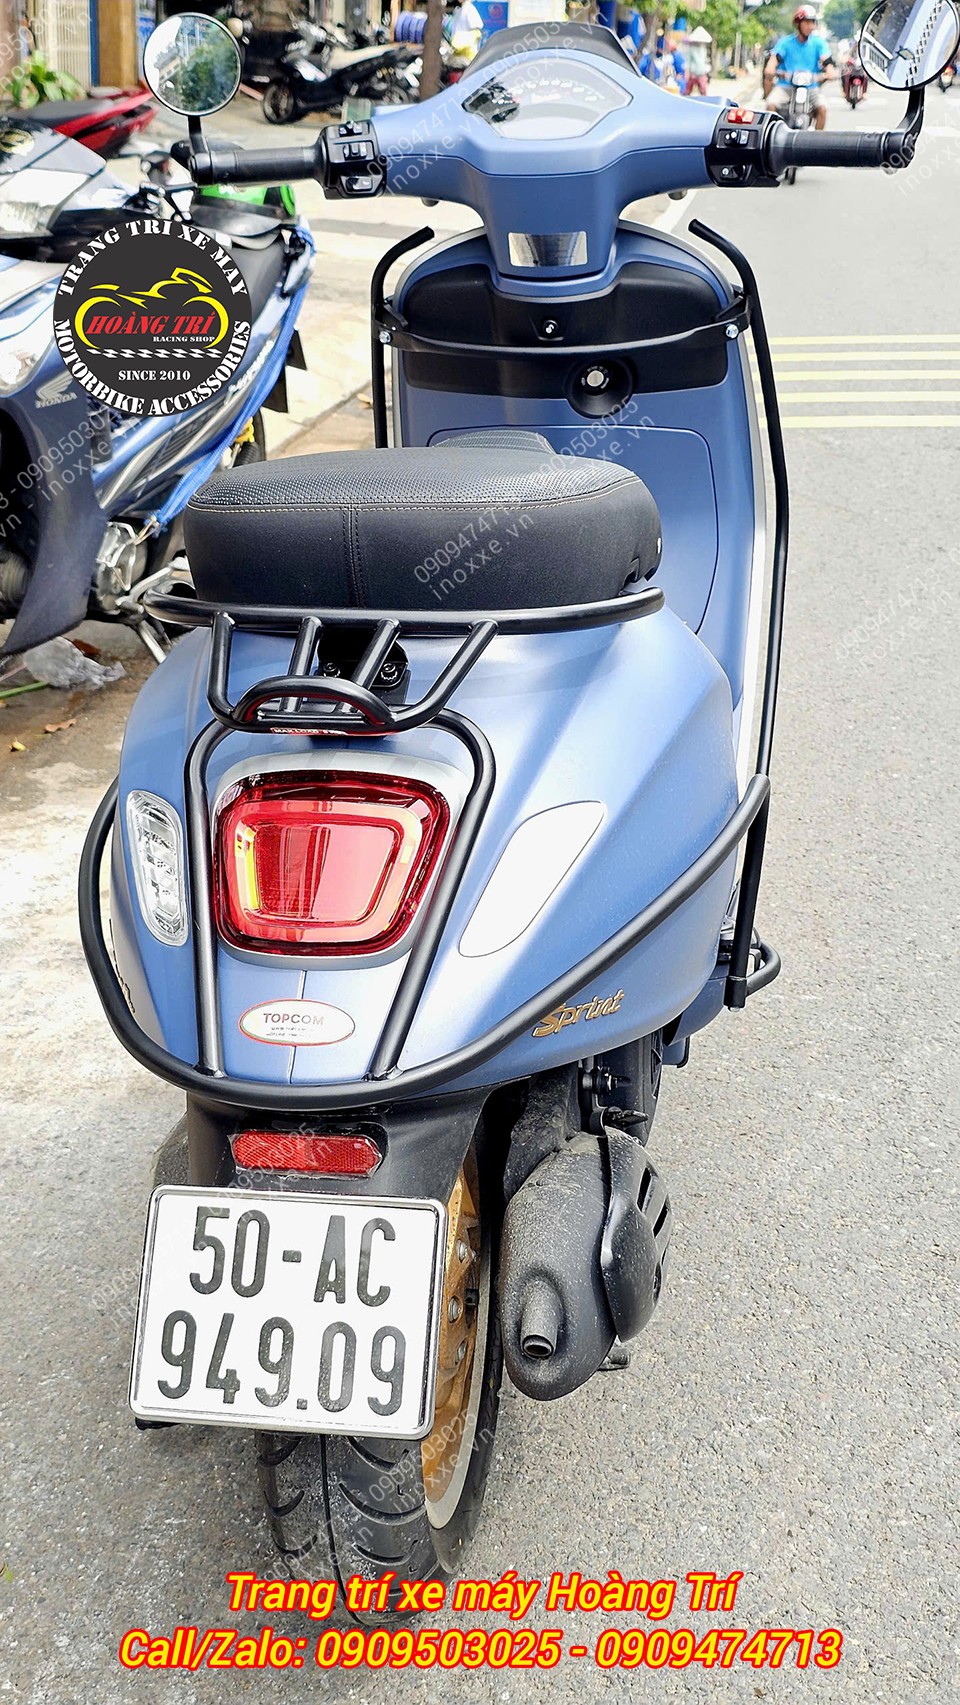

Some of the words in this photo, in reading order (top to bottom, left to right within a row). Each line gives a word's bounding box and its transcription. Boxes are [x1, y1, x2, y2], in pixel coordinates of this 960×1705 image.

[263, 1013, 325, 1026] TOPCOM
[532, 989, 624, 1037] Sprint
[189, 1205, 397, 1308] 50-AC
[157, 1309, 407, 1417] 949.09
